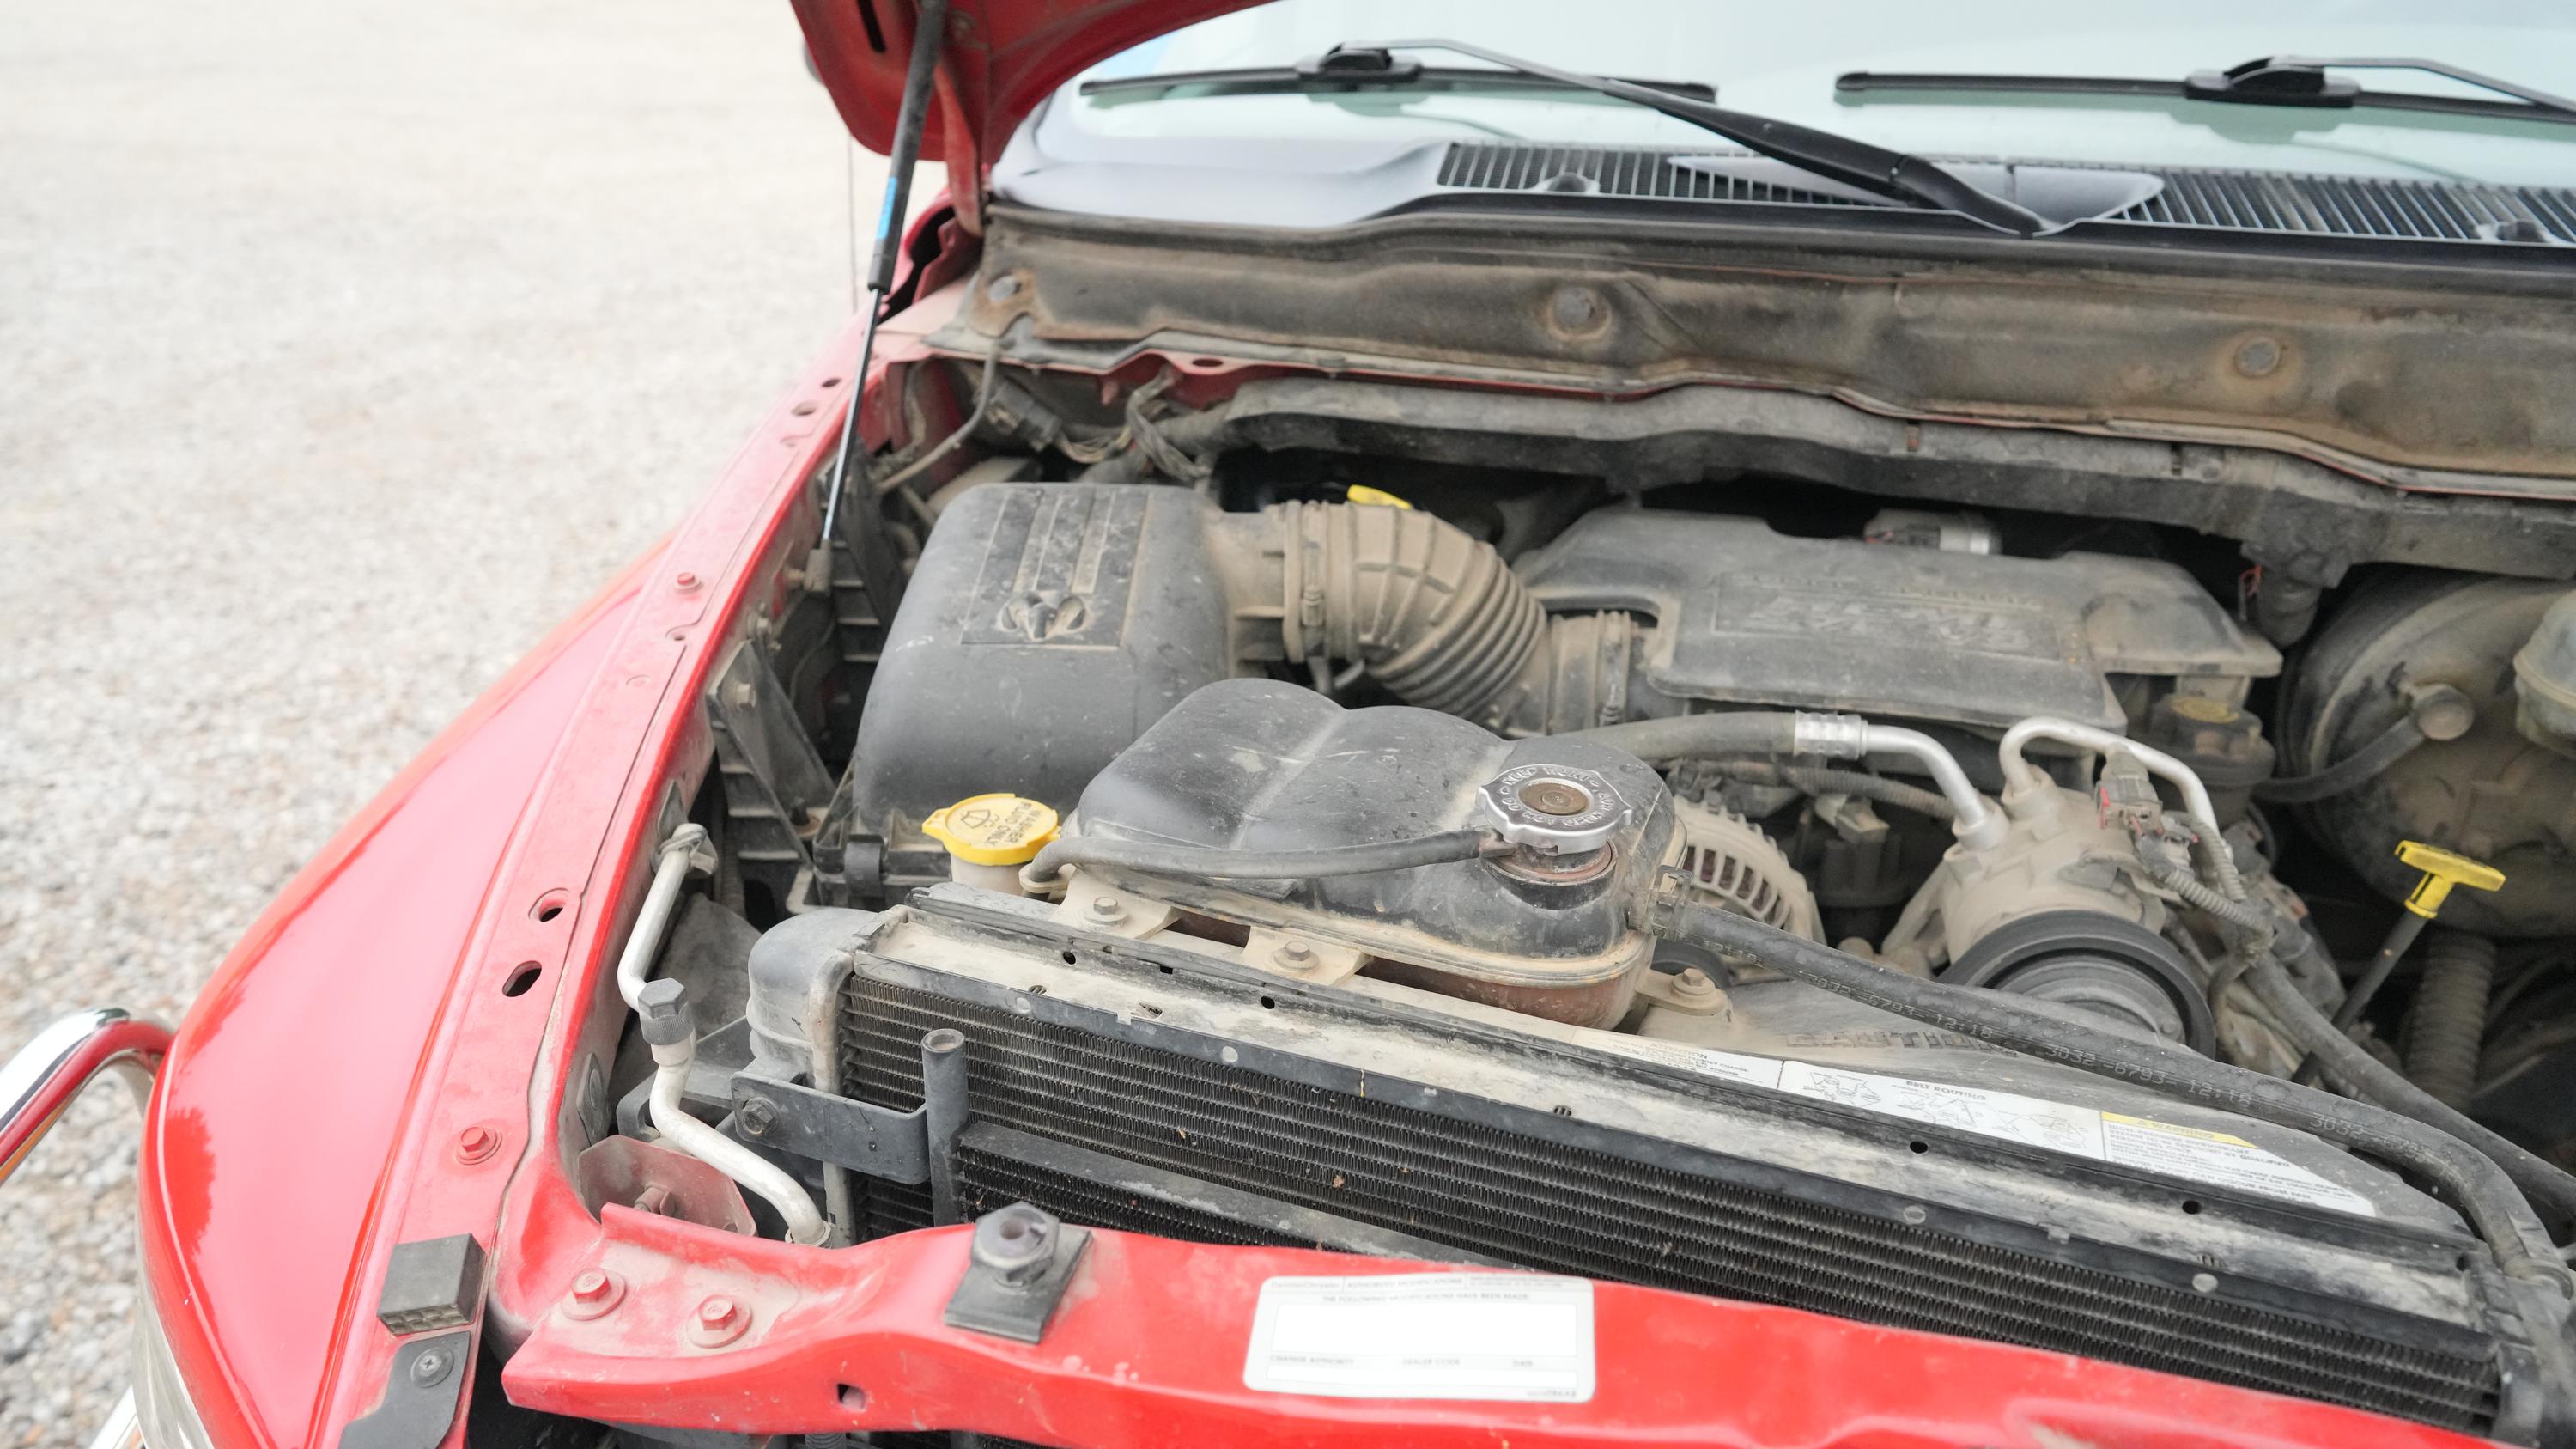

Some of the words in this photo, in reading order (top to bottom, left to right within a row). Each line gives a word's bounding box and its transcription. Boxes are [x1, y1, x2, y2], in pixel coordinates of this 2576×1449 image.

[1562, 811, 1603, 826] OPEN
[1905, 1080, 1930, 1090] BELT
[1934, 1086, 1988, 1101] ROUTING
